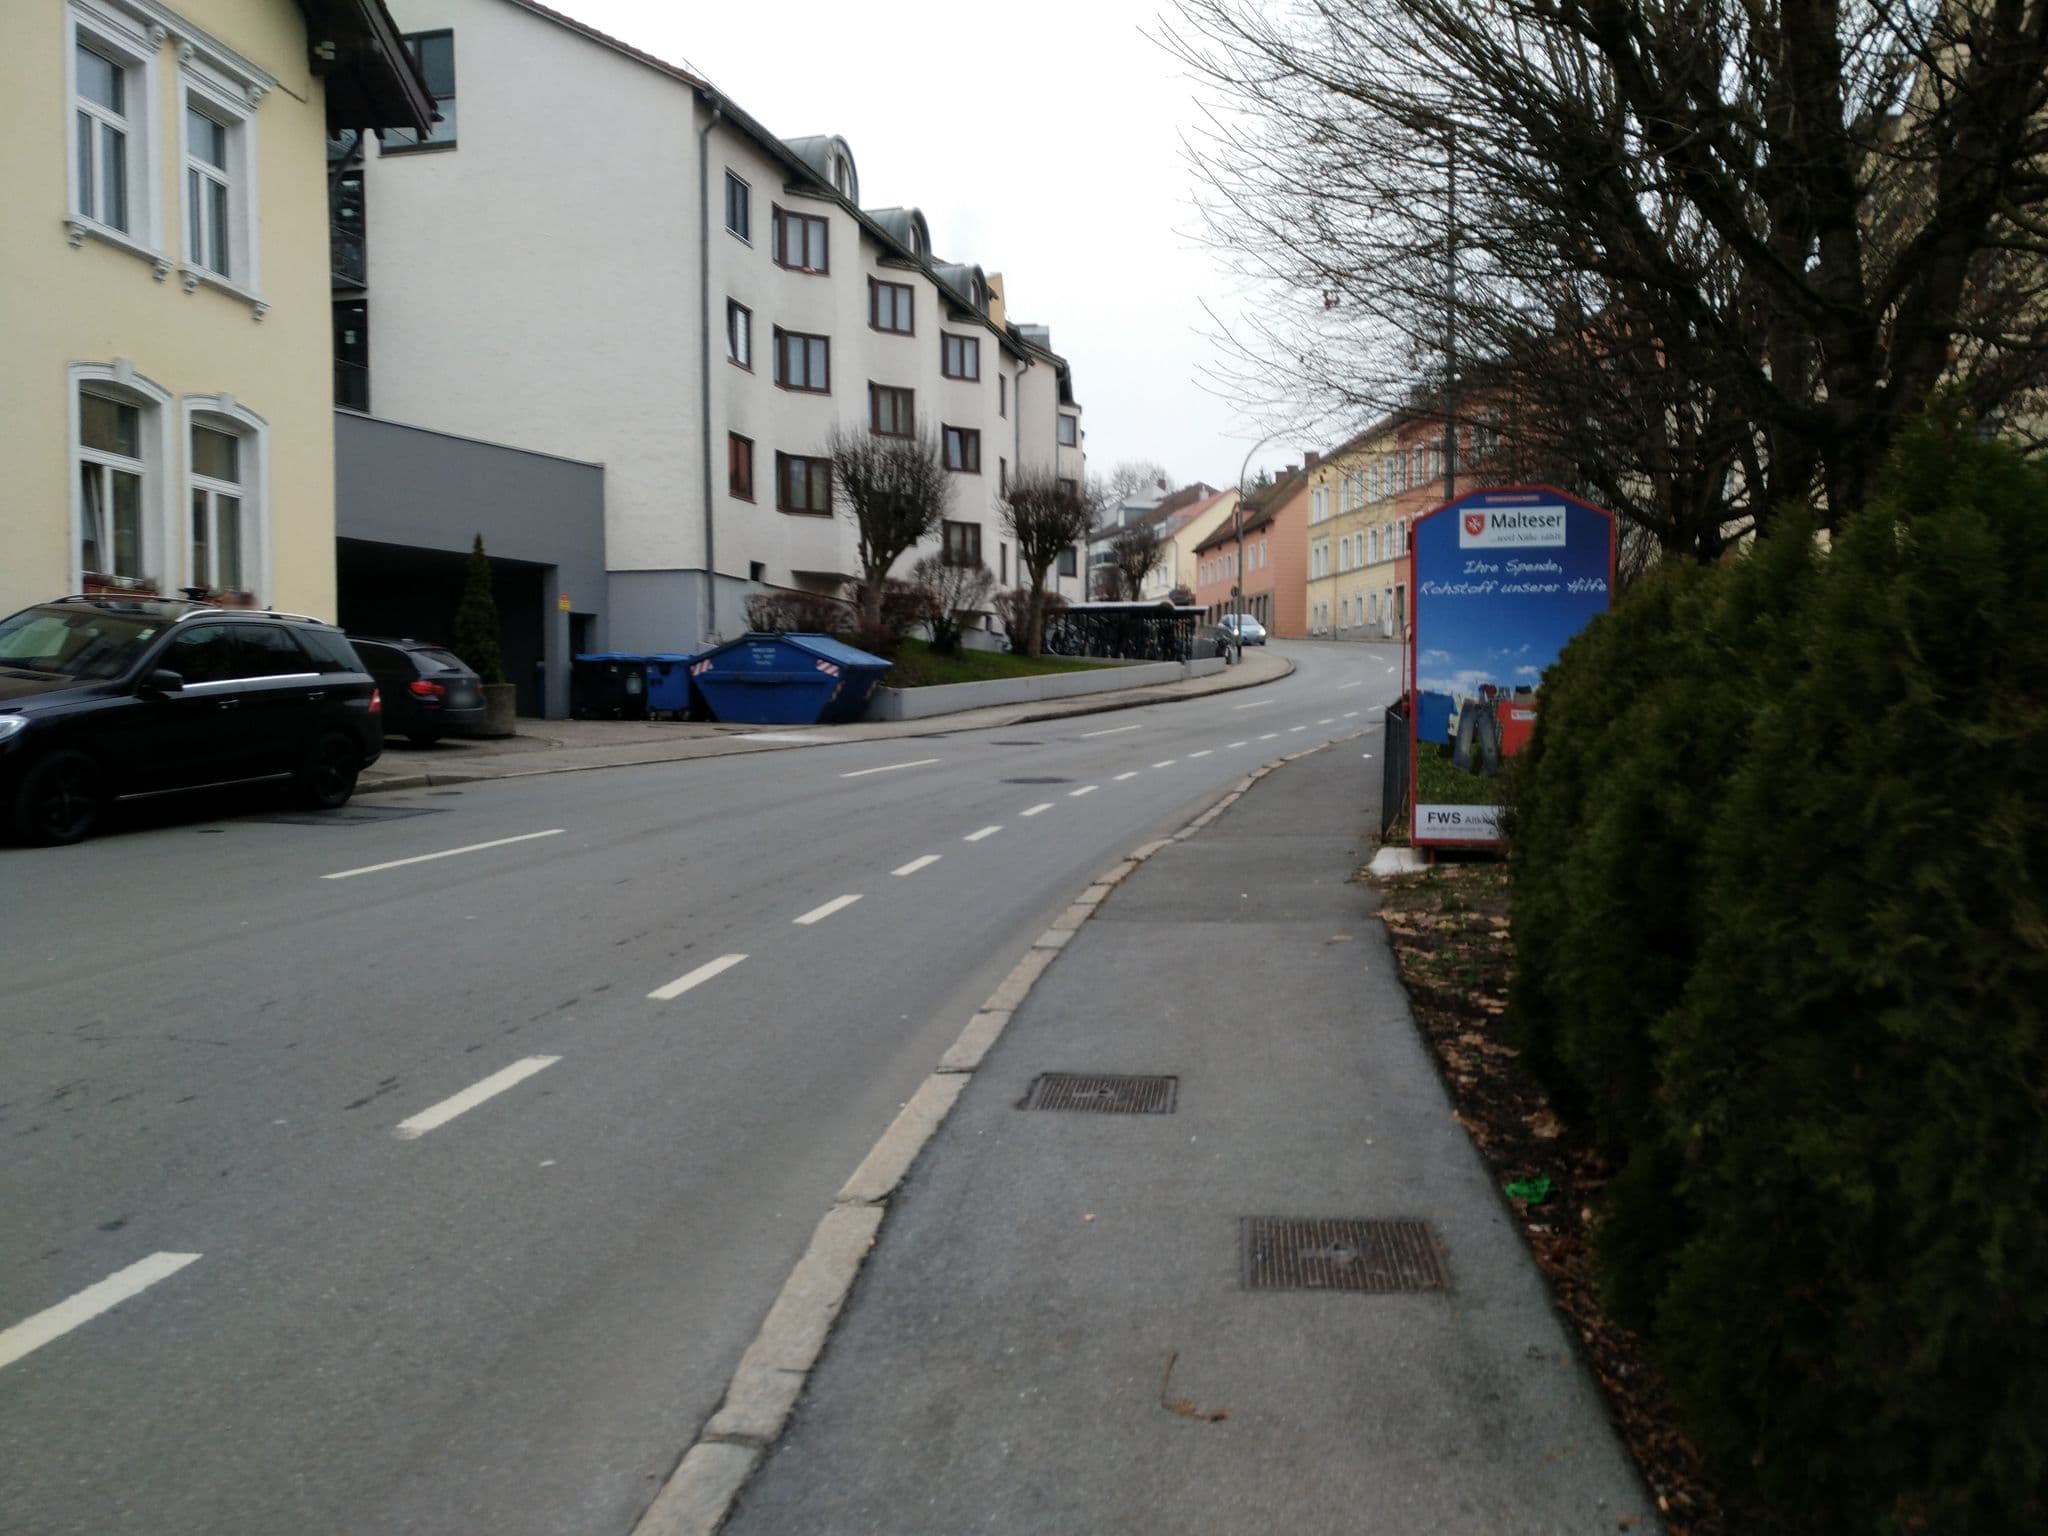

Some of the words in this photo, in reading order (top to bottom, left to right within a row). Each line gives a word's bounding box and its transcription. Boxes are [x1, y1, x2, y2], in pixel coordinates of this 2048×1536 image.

[1491, 512, 1562, 528] Malteser
[1463, 560, 1499, 575] Ihre
[1506, 558, 1563, 576] Spende,
[1419, 580, 1499, 595] Rohstoff
[1500, 582, 1560, 594] unserer
[1567, 578, 1608, 594] Hilfe
[1428, 812, 1462, 825] FWS
